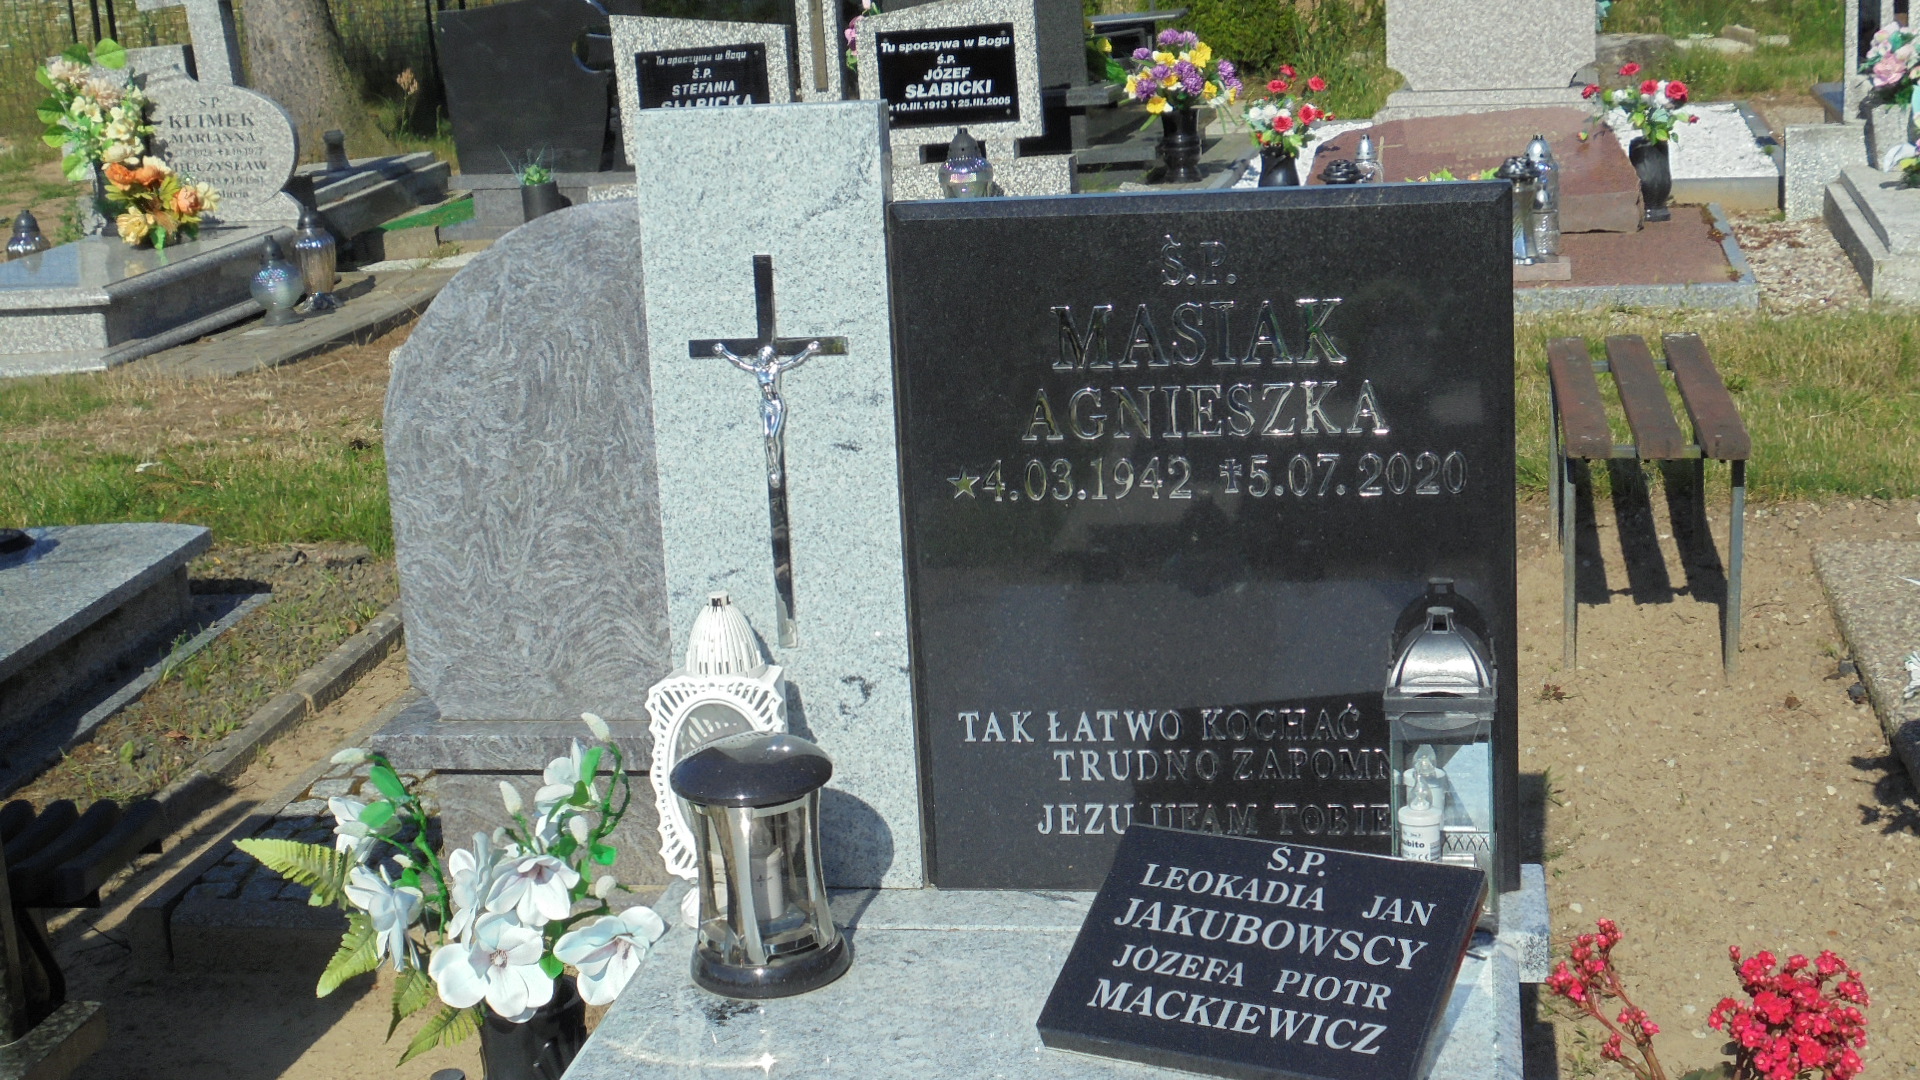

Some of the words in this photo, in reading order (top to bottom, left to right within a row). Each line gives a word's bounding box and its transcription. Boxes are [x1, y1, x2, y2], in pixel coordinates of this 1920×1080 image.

[880, 42, 896, 53] Tu
[899, 38, 960, 54] spoczywa
[963, 37, 975, 47] w
[977, 35, 1010, 49] Bogu
[671, 80, 736, 96] STEFANIA
[904, 78, 992, 99] SŁABICKI
[923, 66, 971, 81] JÓZEF
[168, 113, 255, 129] KLIMEK
[895, 99, 948, 112] 10.III.1913
[169, 132, 256, 144] MARIANNA
[1050, 297, 1347, 370] MASIAK
[1022, 379, 1390, 442] AGNIESZKA
[980, 455, 1193, 502] 4.03.1942
[1248, 450, 1469, 497] 5.07.2020
[957, 709, 1035, 743] TAK
[1046, 708, 1183, 743] ŁATWO
[1200, 702, 1361, 742] KOCHAĆ
[1053, 748, 1220, 782] TRUDNO
[1037, 802, 1134, 836] JEZU
[1273, 802, 1392, 837] TOBIE
[1139, 863, 1325, 912] LEOKADIA
[1361, 895, 1437, 927] JAN
[1112, 897, 1429, 970] JAKUBOWSCY
[1111, 943, 1244, 987] JÓZEFA
[1272, 969, 1392, 1011] PIOTR
[1086, 978, 1388, 1056] MACKIEWICZ
